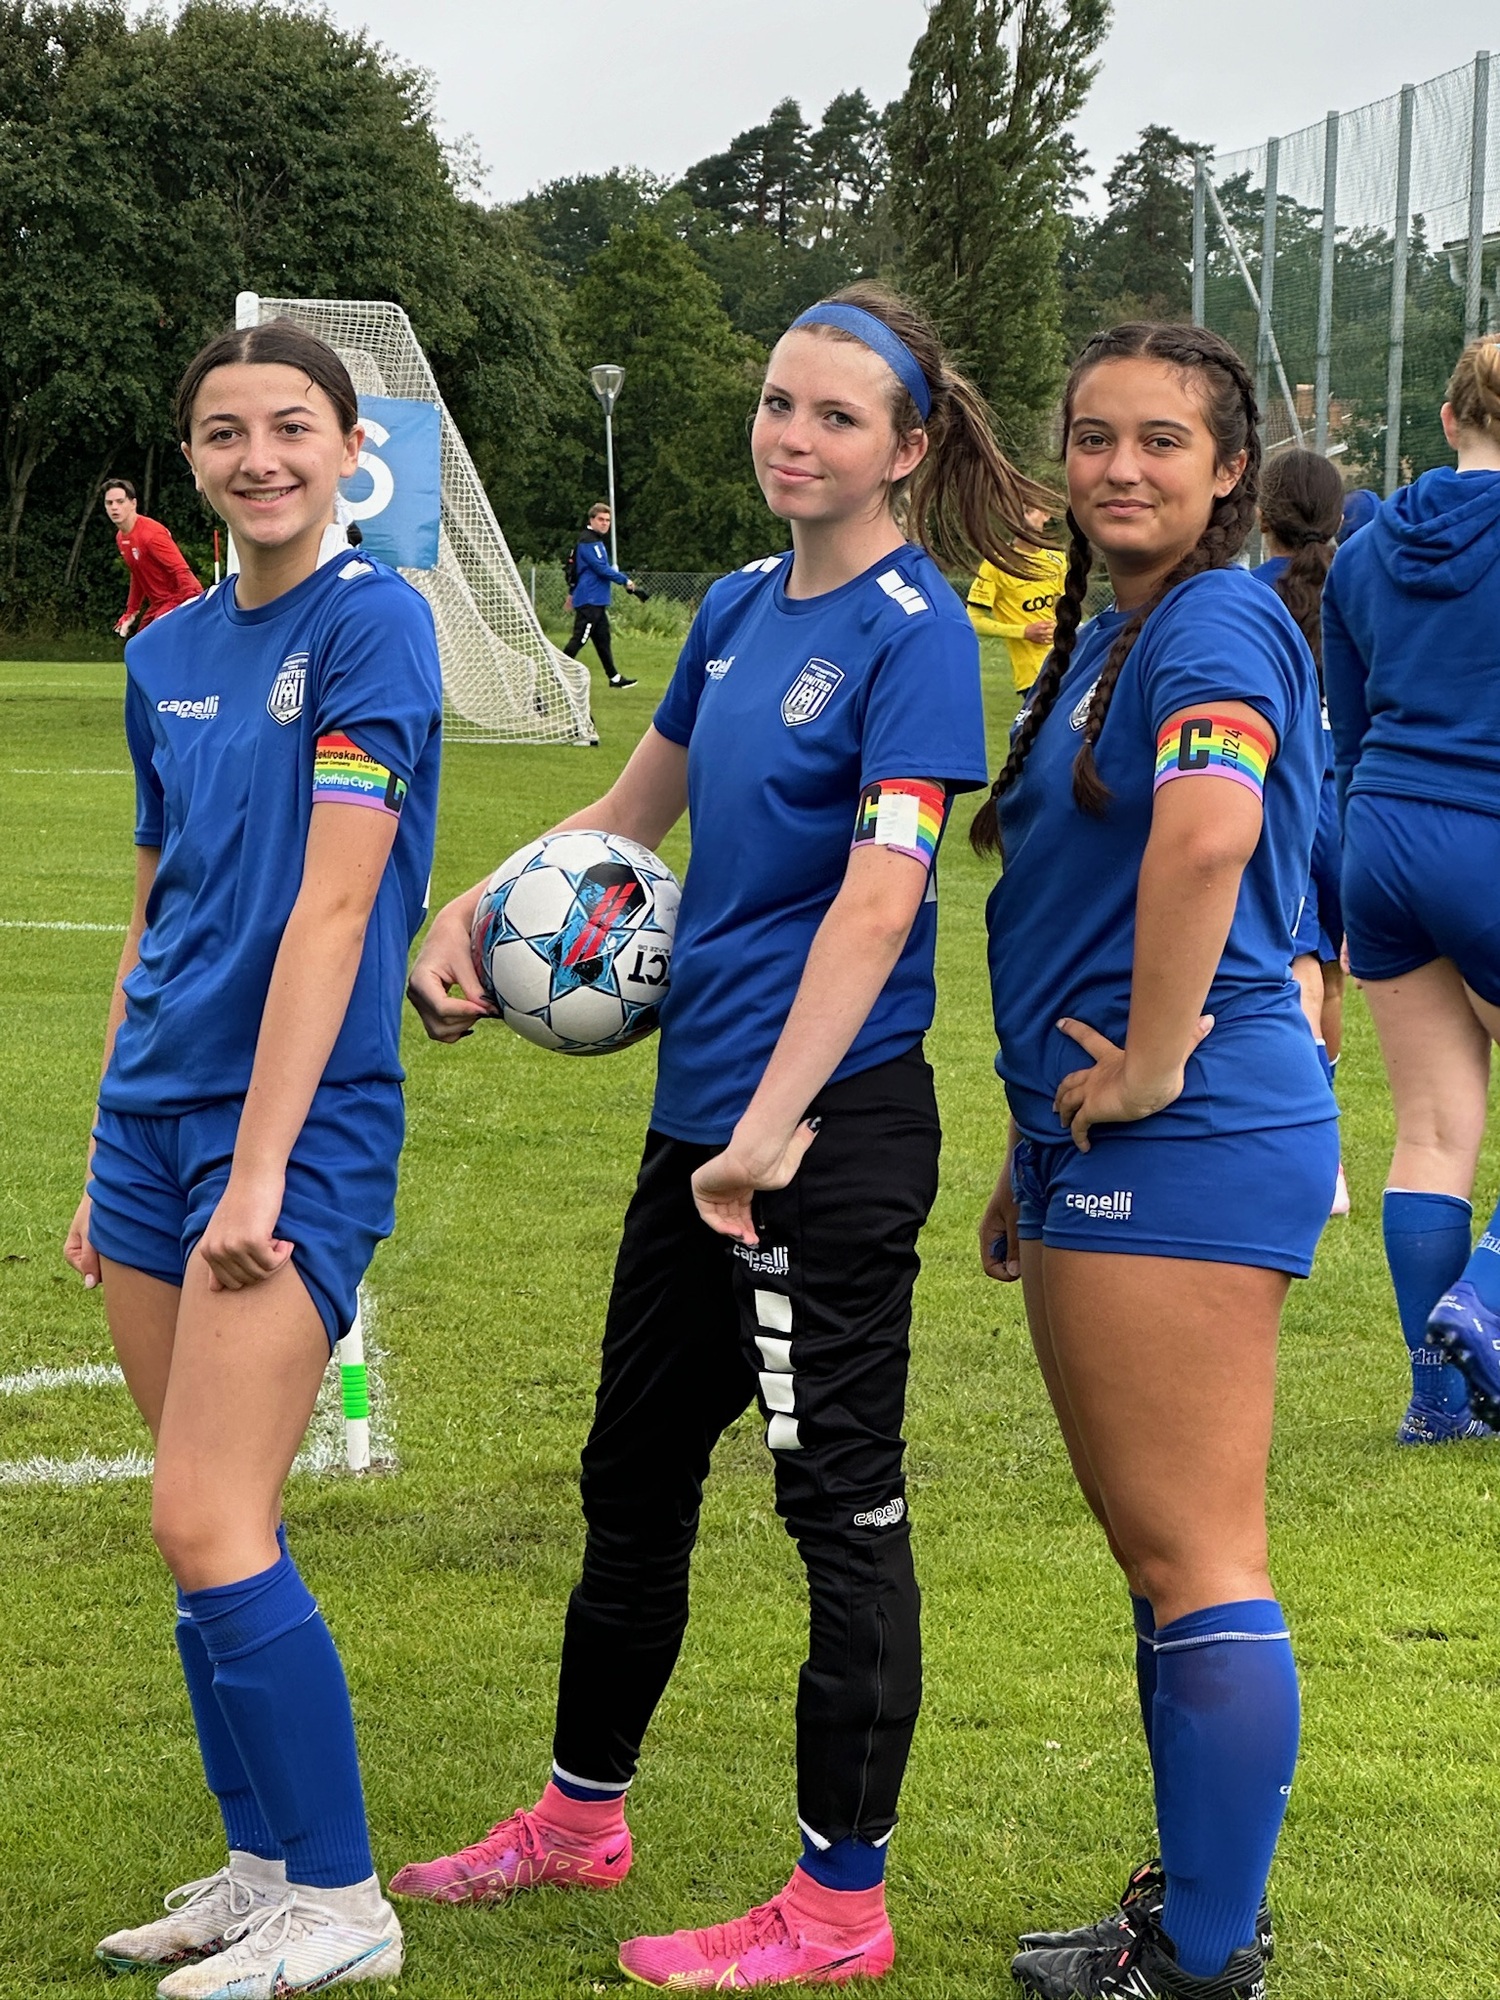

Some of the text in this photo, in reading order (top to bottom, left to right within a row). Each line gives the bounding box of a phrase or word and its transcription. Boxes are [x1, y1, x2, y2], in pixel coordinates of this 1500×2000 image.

[1022, 593, 1056, 612] coo
[801, 672, 832, 693] UNITED
[156, 694, 220, 717] capelli
[180, 712, 217, 720] SPORT
[1178, 718, 1213, 771] C
[1220, 728, 1243, 770] 2024
[318, 772, 350, 786] Gothia
[350, 775, 374, 792] Cup
[1065, 1190, 1133, 1215] capelli
[1089, 1209, 1132, 1221] SPORT
[732, 1243, 789, 1269] capelli
[752, 1262, 790, 1276] SPORT
[853, 1496, 906, 1527] capelli
